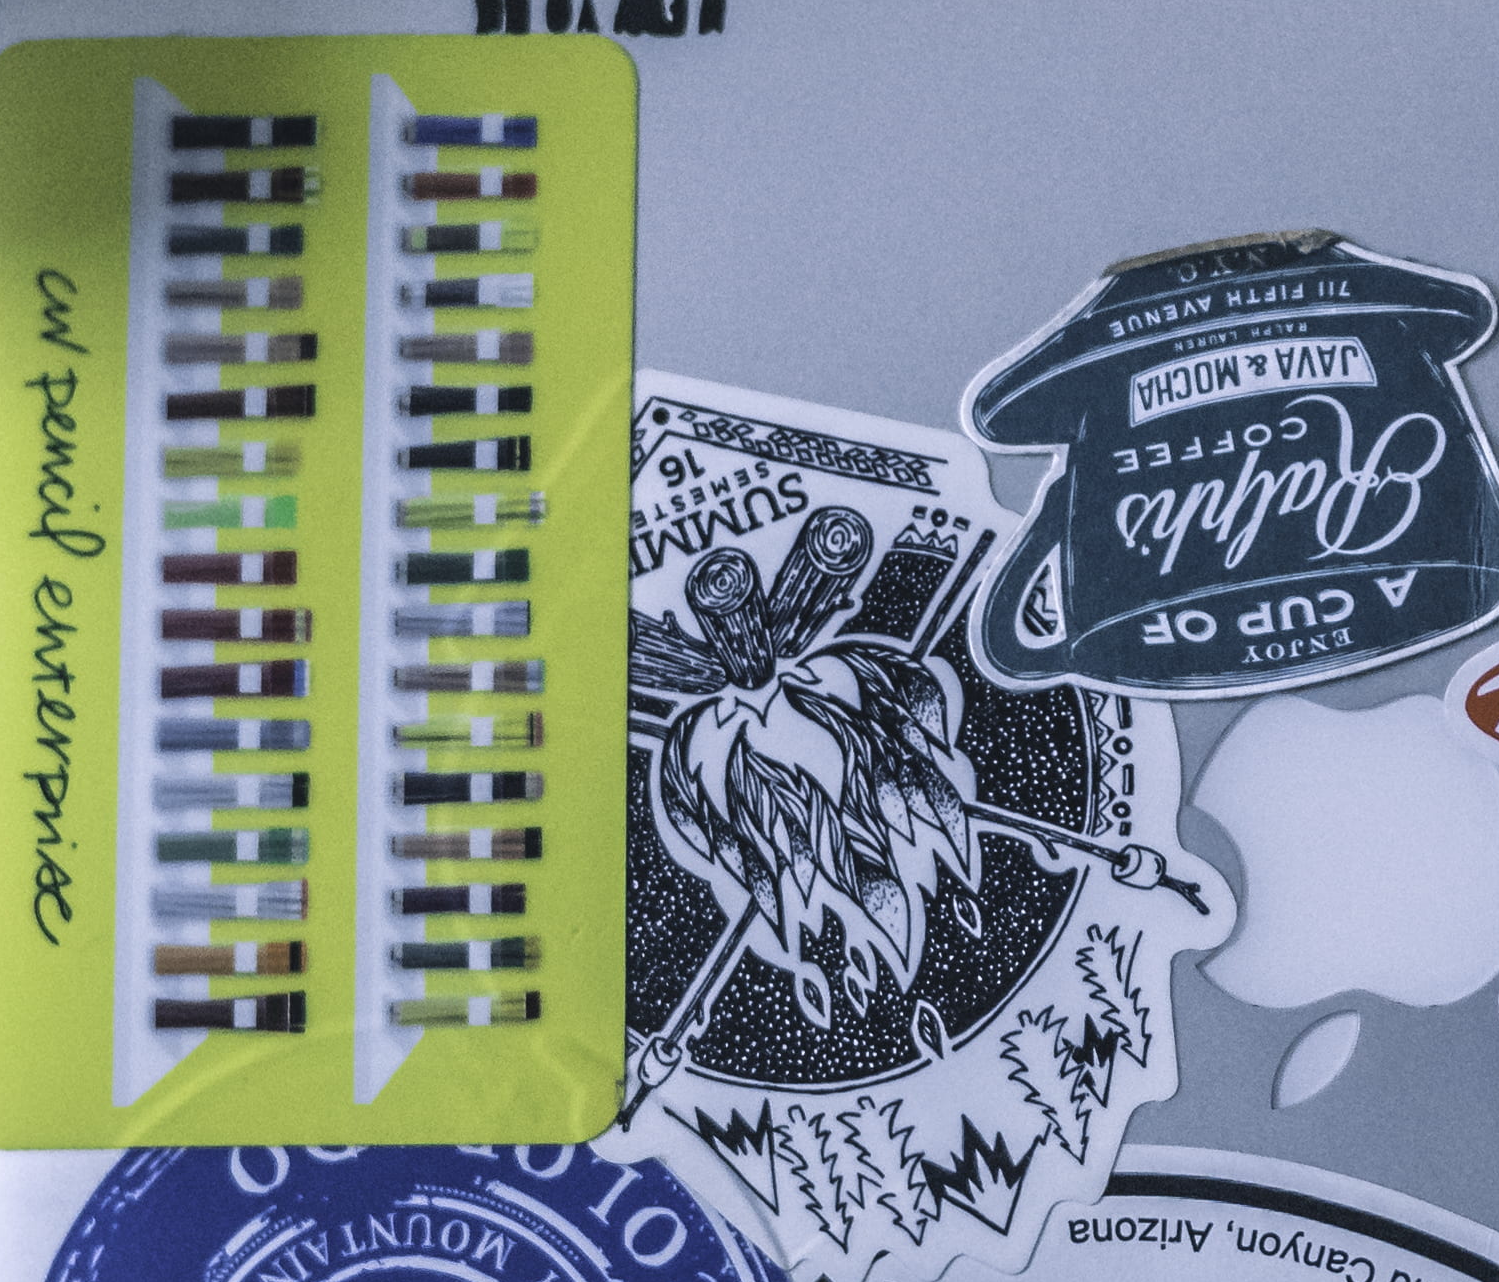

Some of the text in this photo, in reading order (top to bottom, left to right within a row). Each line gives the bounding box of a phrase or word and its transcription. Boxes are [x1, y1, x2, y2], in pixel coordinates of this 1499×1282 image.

[1108, 280, 1350, 338] 711 FIFTH AVENUE
[1173, 321, 1308, 352] RALPH LAUREN
[1138, 344, 1359, 411] JAVA & MOCHA
[23, 369, 107, 558] pencil
[659, 448, 705, 488] 16
[1113, 417, 1308, 474] COFFEE
[631, 460, 770, 529] SEMESTE
[1115, 393, 1447, 577] Ralph's
[629, 472, 809, 578] SUMMI
[1141, 569, 1418, 646] A CUP OF
[1241, 626, 1354, 665] ENJOY
[22, 575, 81, 947] enterprise
[1068, 1217, 1213, 1252] Arizona
